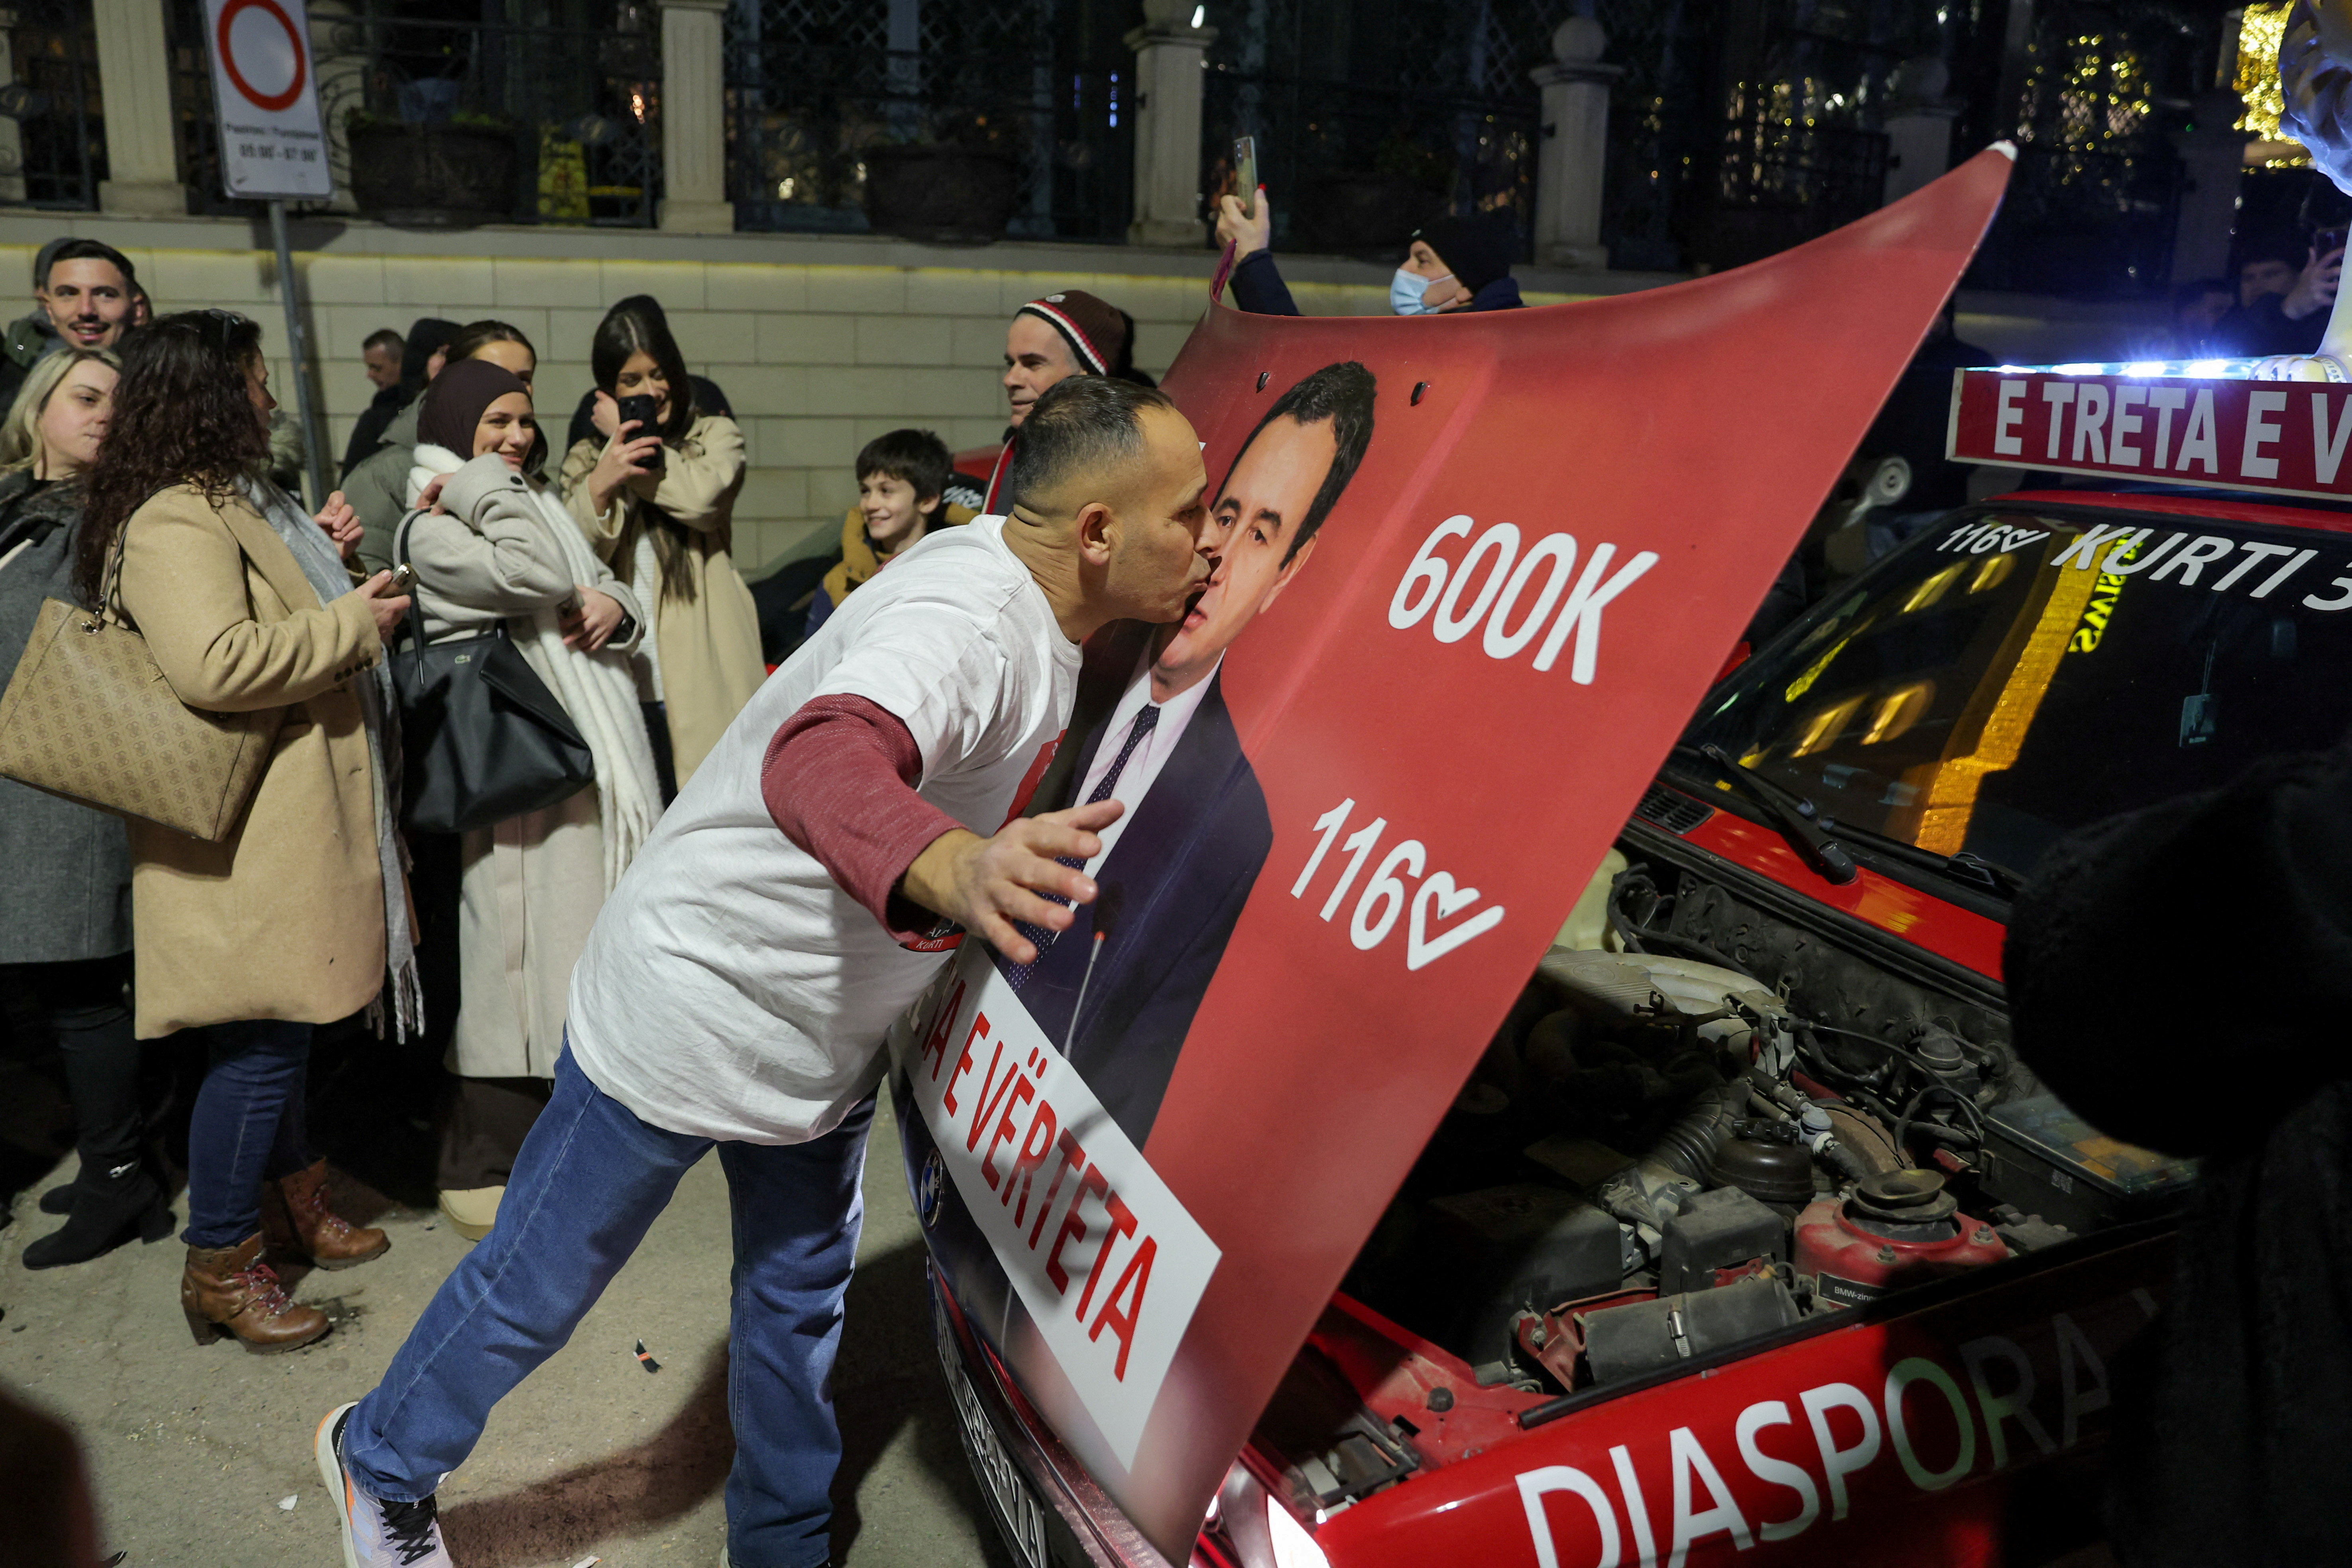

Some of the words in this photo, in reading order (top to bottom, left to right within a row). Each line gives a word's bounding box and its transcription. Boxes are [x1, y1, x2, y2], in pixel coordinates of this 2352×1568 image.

[1994, 380, 2027, 456] E
[2042, 381, 2218, 474] TRETA
[2240, 390, 2287, 479] E
[1388, 514, 1660, 685] 600K
[2050, 523, 2318, 598] KURTI
[916, 939, 944, 949] KURTI
[943, 1011, 991, 1119] E
[966, 1041, 1158, 1383] VËRTETA
[1515, 1312, 2112, 1568] DIASPORA
